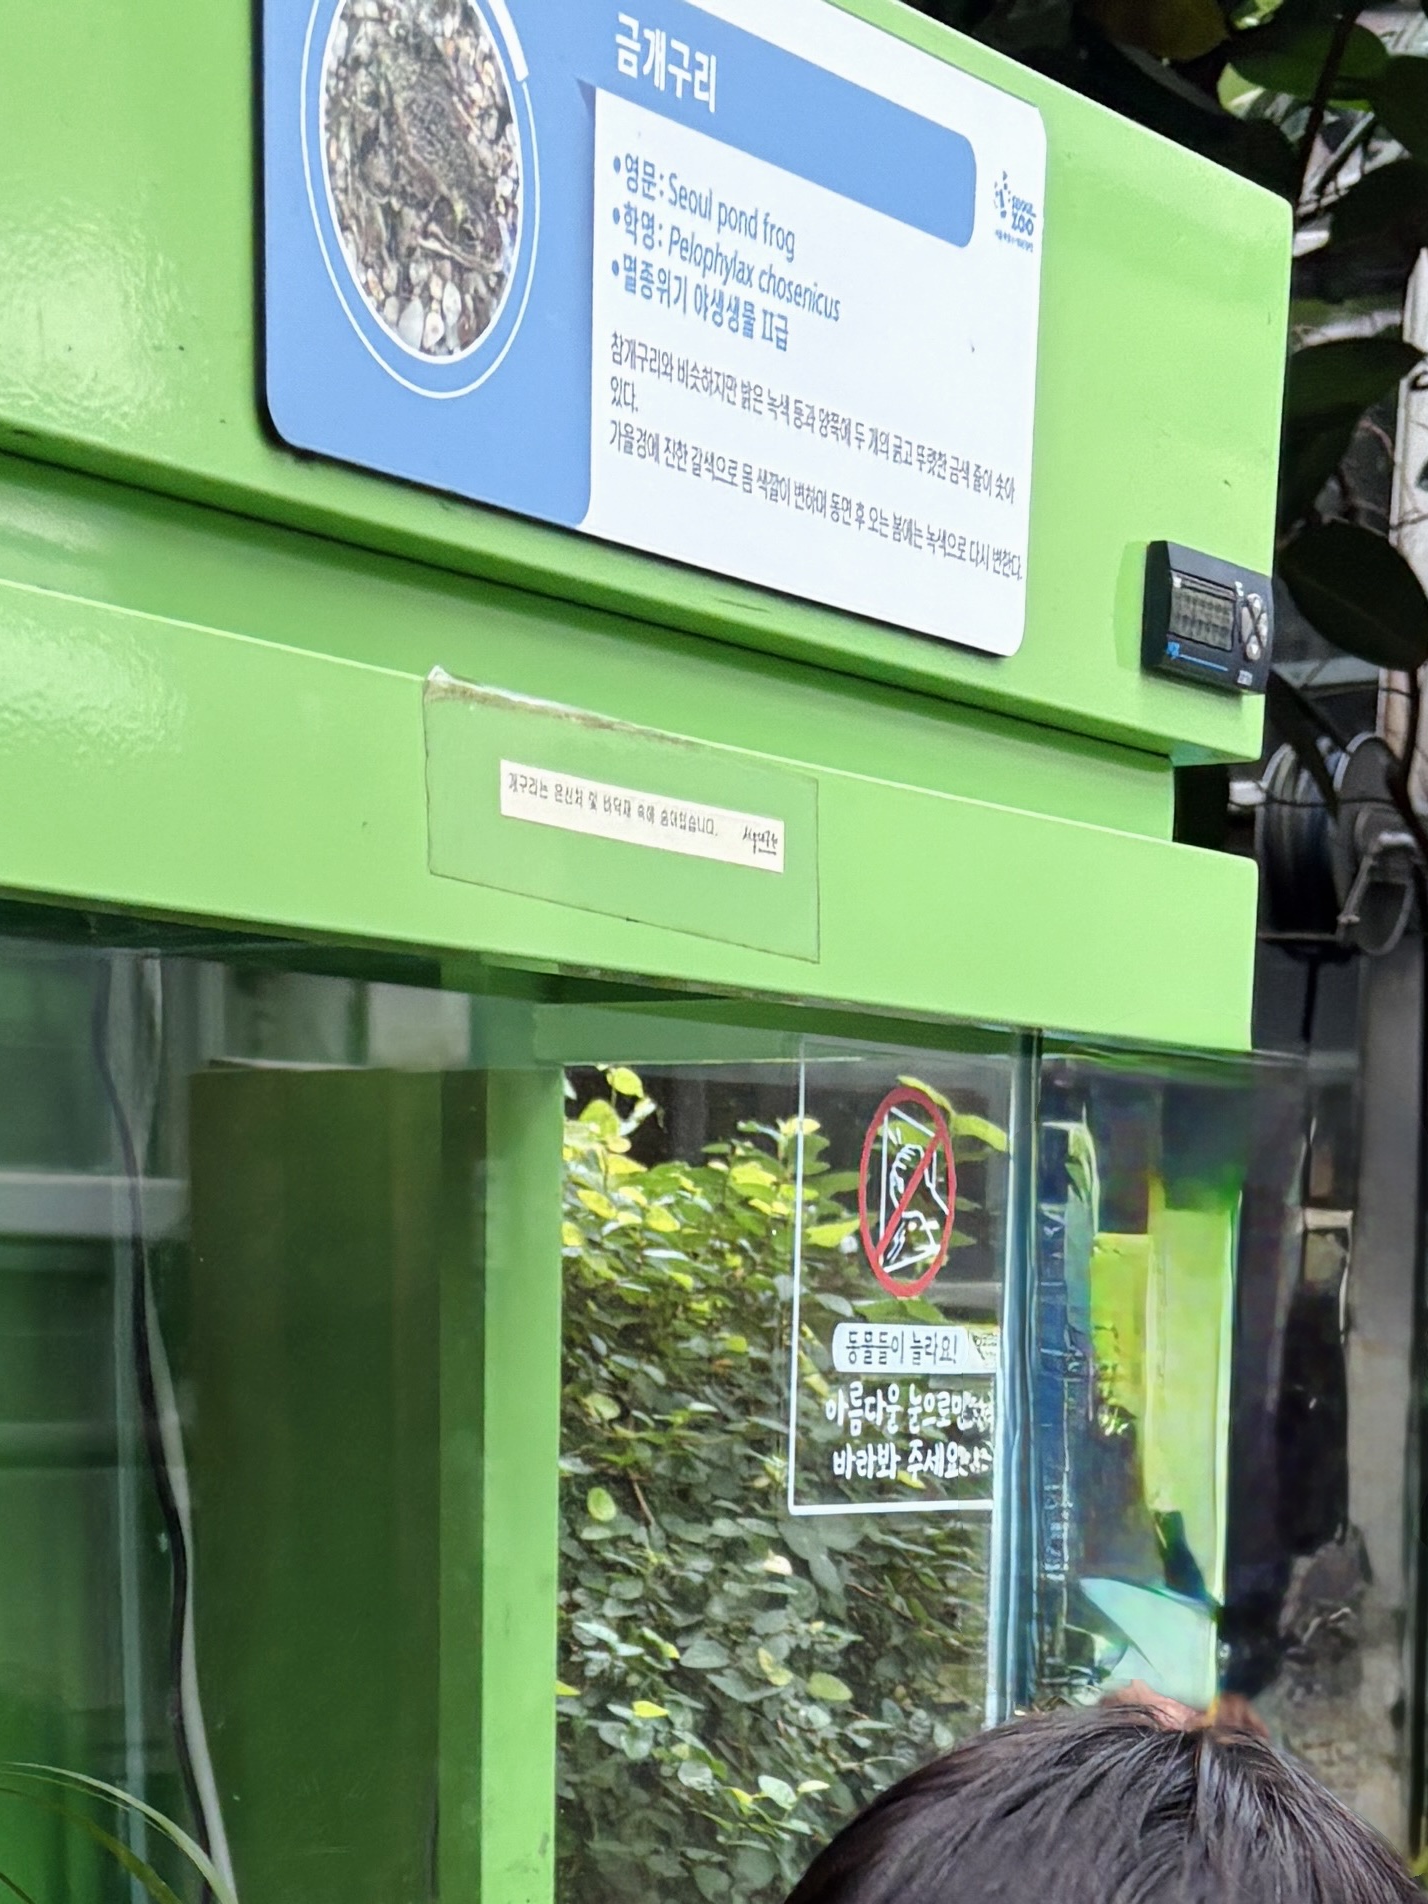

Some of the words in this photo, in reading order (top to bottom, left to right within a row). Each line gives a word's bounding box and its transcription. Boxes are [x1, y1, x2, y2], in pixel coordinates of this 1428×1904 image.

[615, 11, 717, 114] 금개구리
[668, 172, 713, 221] Seoul
[717, 200, 758, 241] pond
[763, 211, 795, 263] frog
[623, 254, 687, 315] 멸종위기
[694, 283, 756, 339] 야생생물
[668, 225, 755, 287] Pelophylax
[758, 264, 841, 322] chosenicus
[610, 376, 638, 413] 있다.
[611, 331, 674, 382] 참개구리와
[677, 357, 737, 406] 비슷하지만
[741, 379, 763, 415] 밝은
[767, 388, 790, 426] 녹색
[793, 399, 816, 434] 등과
[854, 422, 865, 450] 두
[868, 427, 890, 460] 개의
[949, 455, 970, 489] 금색
[973, 463, 992, 497] 줄이
[609, 419, 660, 464] 가을경에
[664, 436, 687, 472] 진한
[691, 446, 738, 487] 갈색으로
[830, 492, 852, 526] 동면
[854, 502, 865, 531] 후
[868, 506, 890, 538] 오는
[893, 512, 924, 550] 봄에는
[926, 523, 967, 562] 녹색으로
[970, 540, 990, 571] 다시
[509, 772, 548, 800] 개구리는
[846, 1330, 905, 1365] 동물들이
[825, 1381, 903, 1437] 아름다운
[832, 1442, 902, 1480] 바라봐
